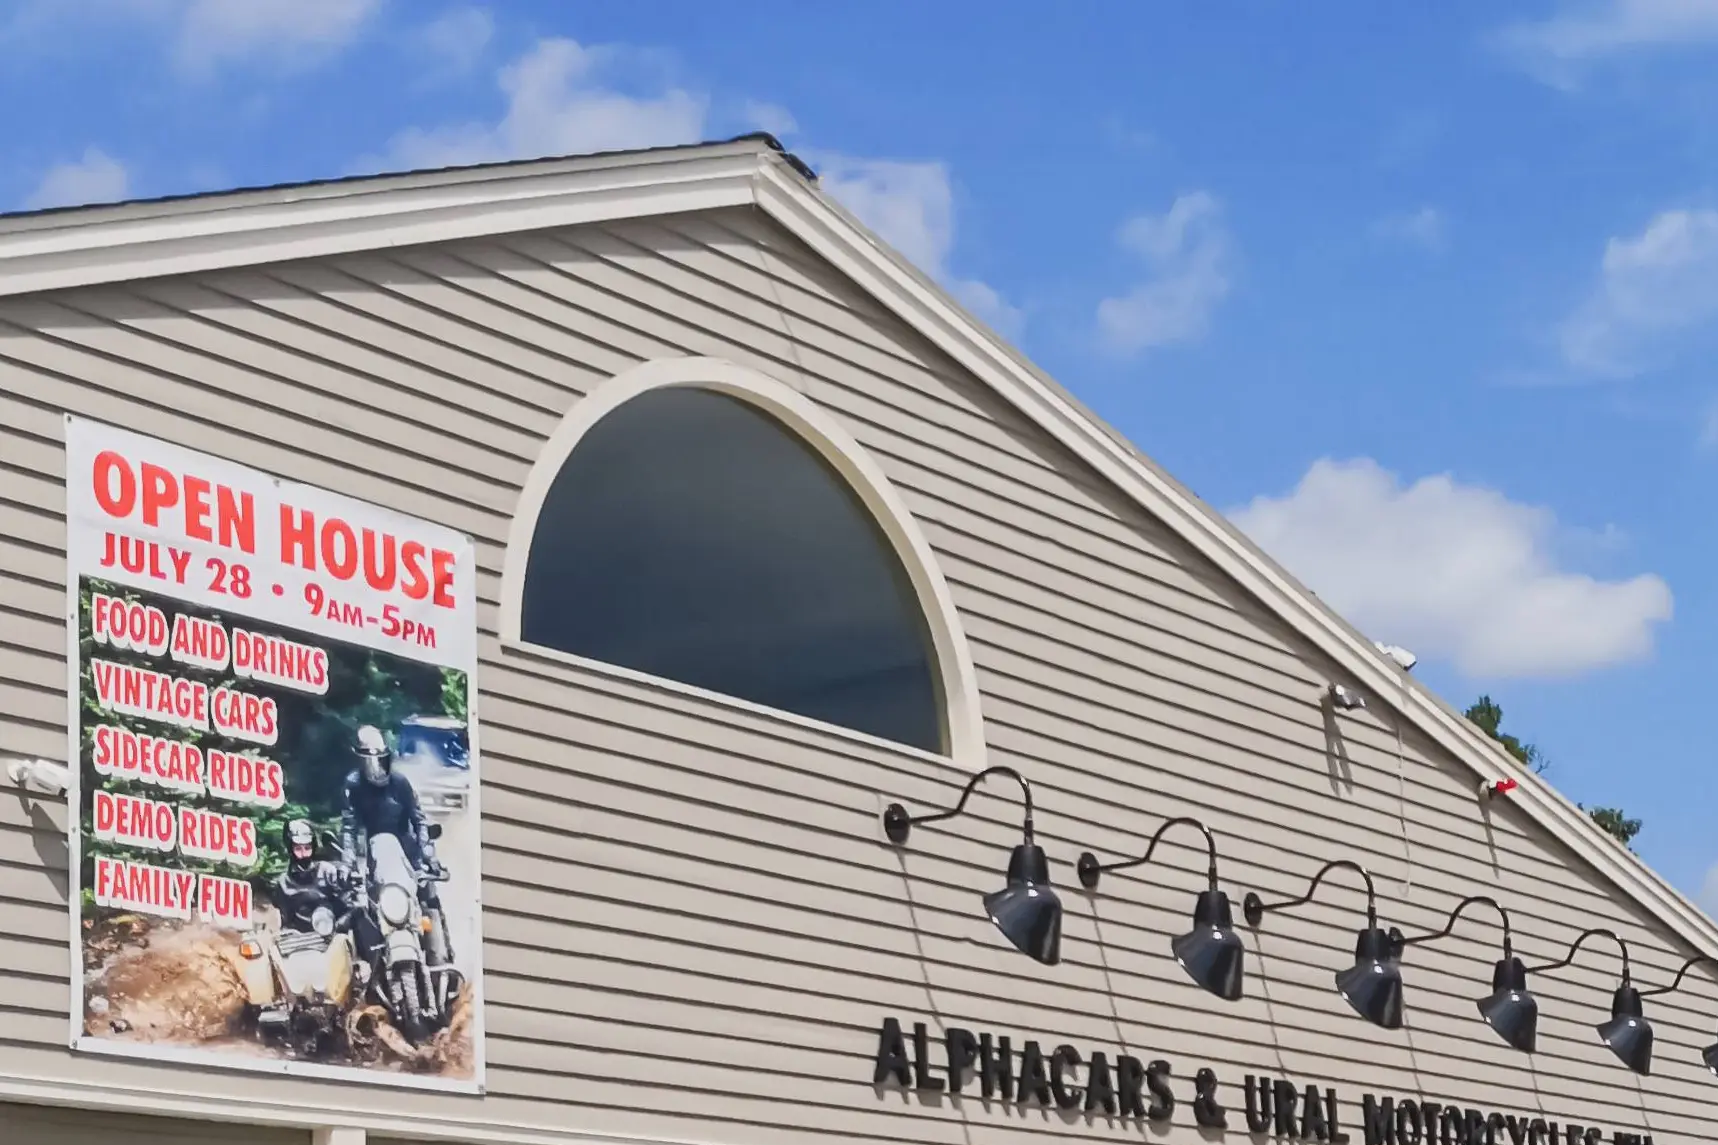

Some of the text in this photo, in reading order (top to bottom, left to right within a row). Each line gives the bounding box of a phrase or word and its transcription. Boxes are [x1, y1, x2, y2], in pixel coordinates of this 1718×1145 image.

[93, 450, 456, 609] OPEN HOUSE
[101, 532, 436, 648] JULY 28 9AM-5PM
[95, 596, 325, 686] FOOD AND DRINKS
[94, 662, 275, 737] VINTAGE CARS
[96, 727, 280, 800] SIDECAR RIDES
[96, 794, 253, 858] DEMO RIDES
[97, 861, 249, 919] FAMILY FUN
[873, 1016, 1175, 1122] ALPHACARS
[1193, 1067, 1227, 1128] &
[1244, 1074, 1349, 1144] URAL
